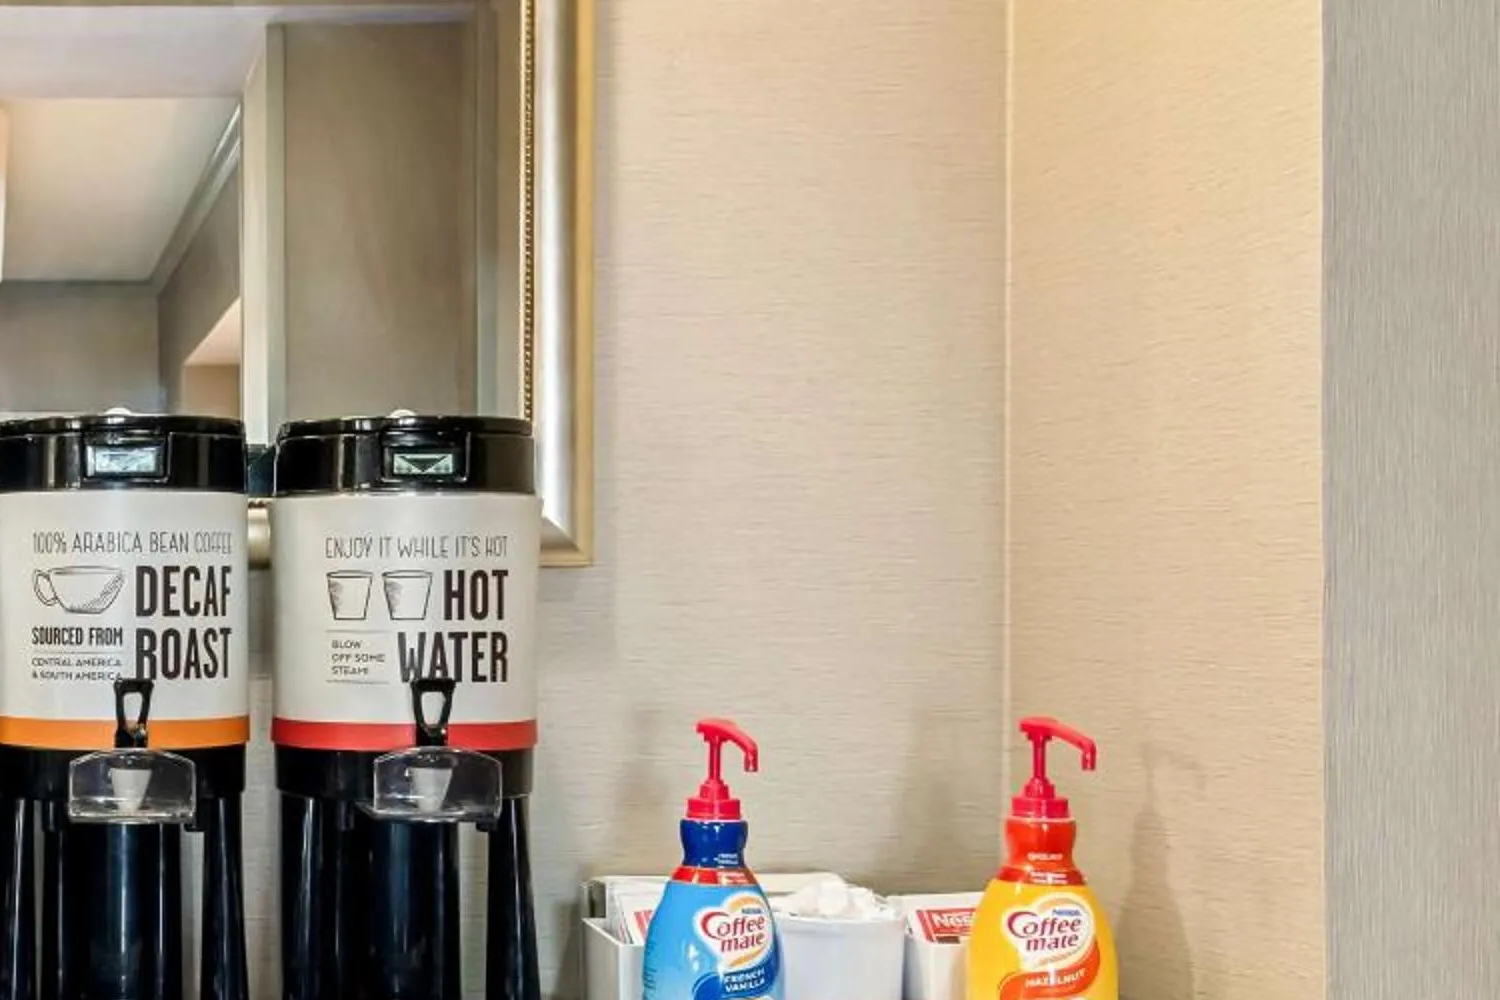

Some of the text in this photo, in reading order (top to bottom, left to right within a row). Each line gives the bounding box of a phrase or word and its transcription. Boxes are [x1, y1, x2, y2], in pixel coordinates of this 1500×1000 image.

[32, 531, 233, 555] 100% ARABICA BEAN COFFEE
[325, 535, 509, 559] ENJOY IT WHILE IT'S HOT
[135, 565, 233, 618] DECAF
[443, 569, 510, 621] HOT
[31, 626, 124, 646] SOURCED FROM
[331, 639, 363, 649] BLOW
[31, 657, 123, 667] CENTRAL AMERICA
[135, 627, 233, 681] ROAST
[331, 653, 386, 664] OFF SOME
[396, 631, 510, 684] WATER
[40, 671, 72, 681] SOUTH
[74, 671, 124, 682] AMERICA
[700, 911, 766, 941] Coffee
[1007, 911, 1082, 939] Coffee
[720, 932, 765, 953] mate
[1025, 934, 1079, 952] mate
[724, 967, 765, 984] FRENCH
[725, 978, 765, 993] VANILLA
